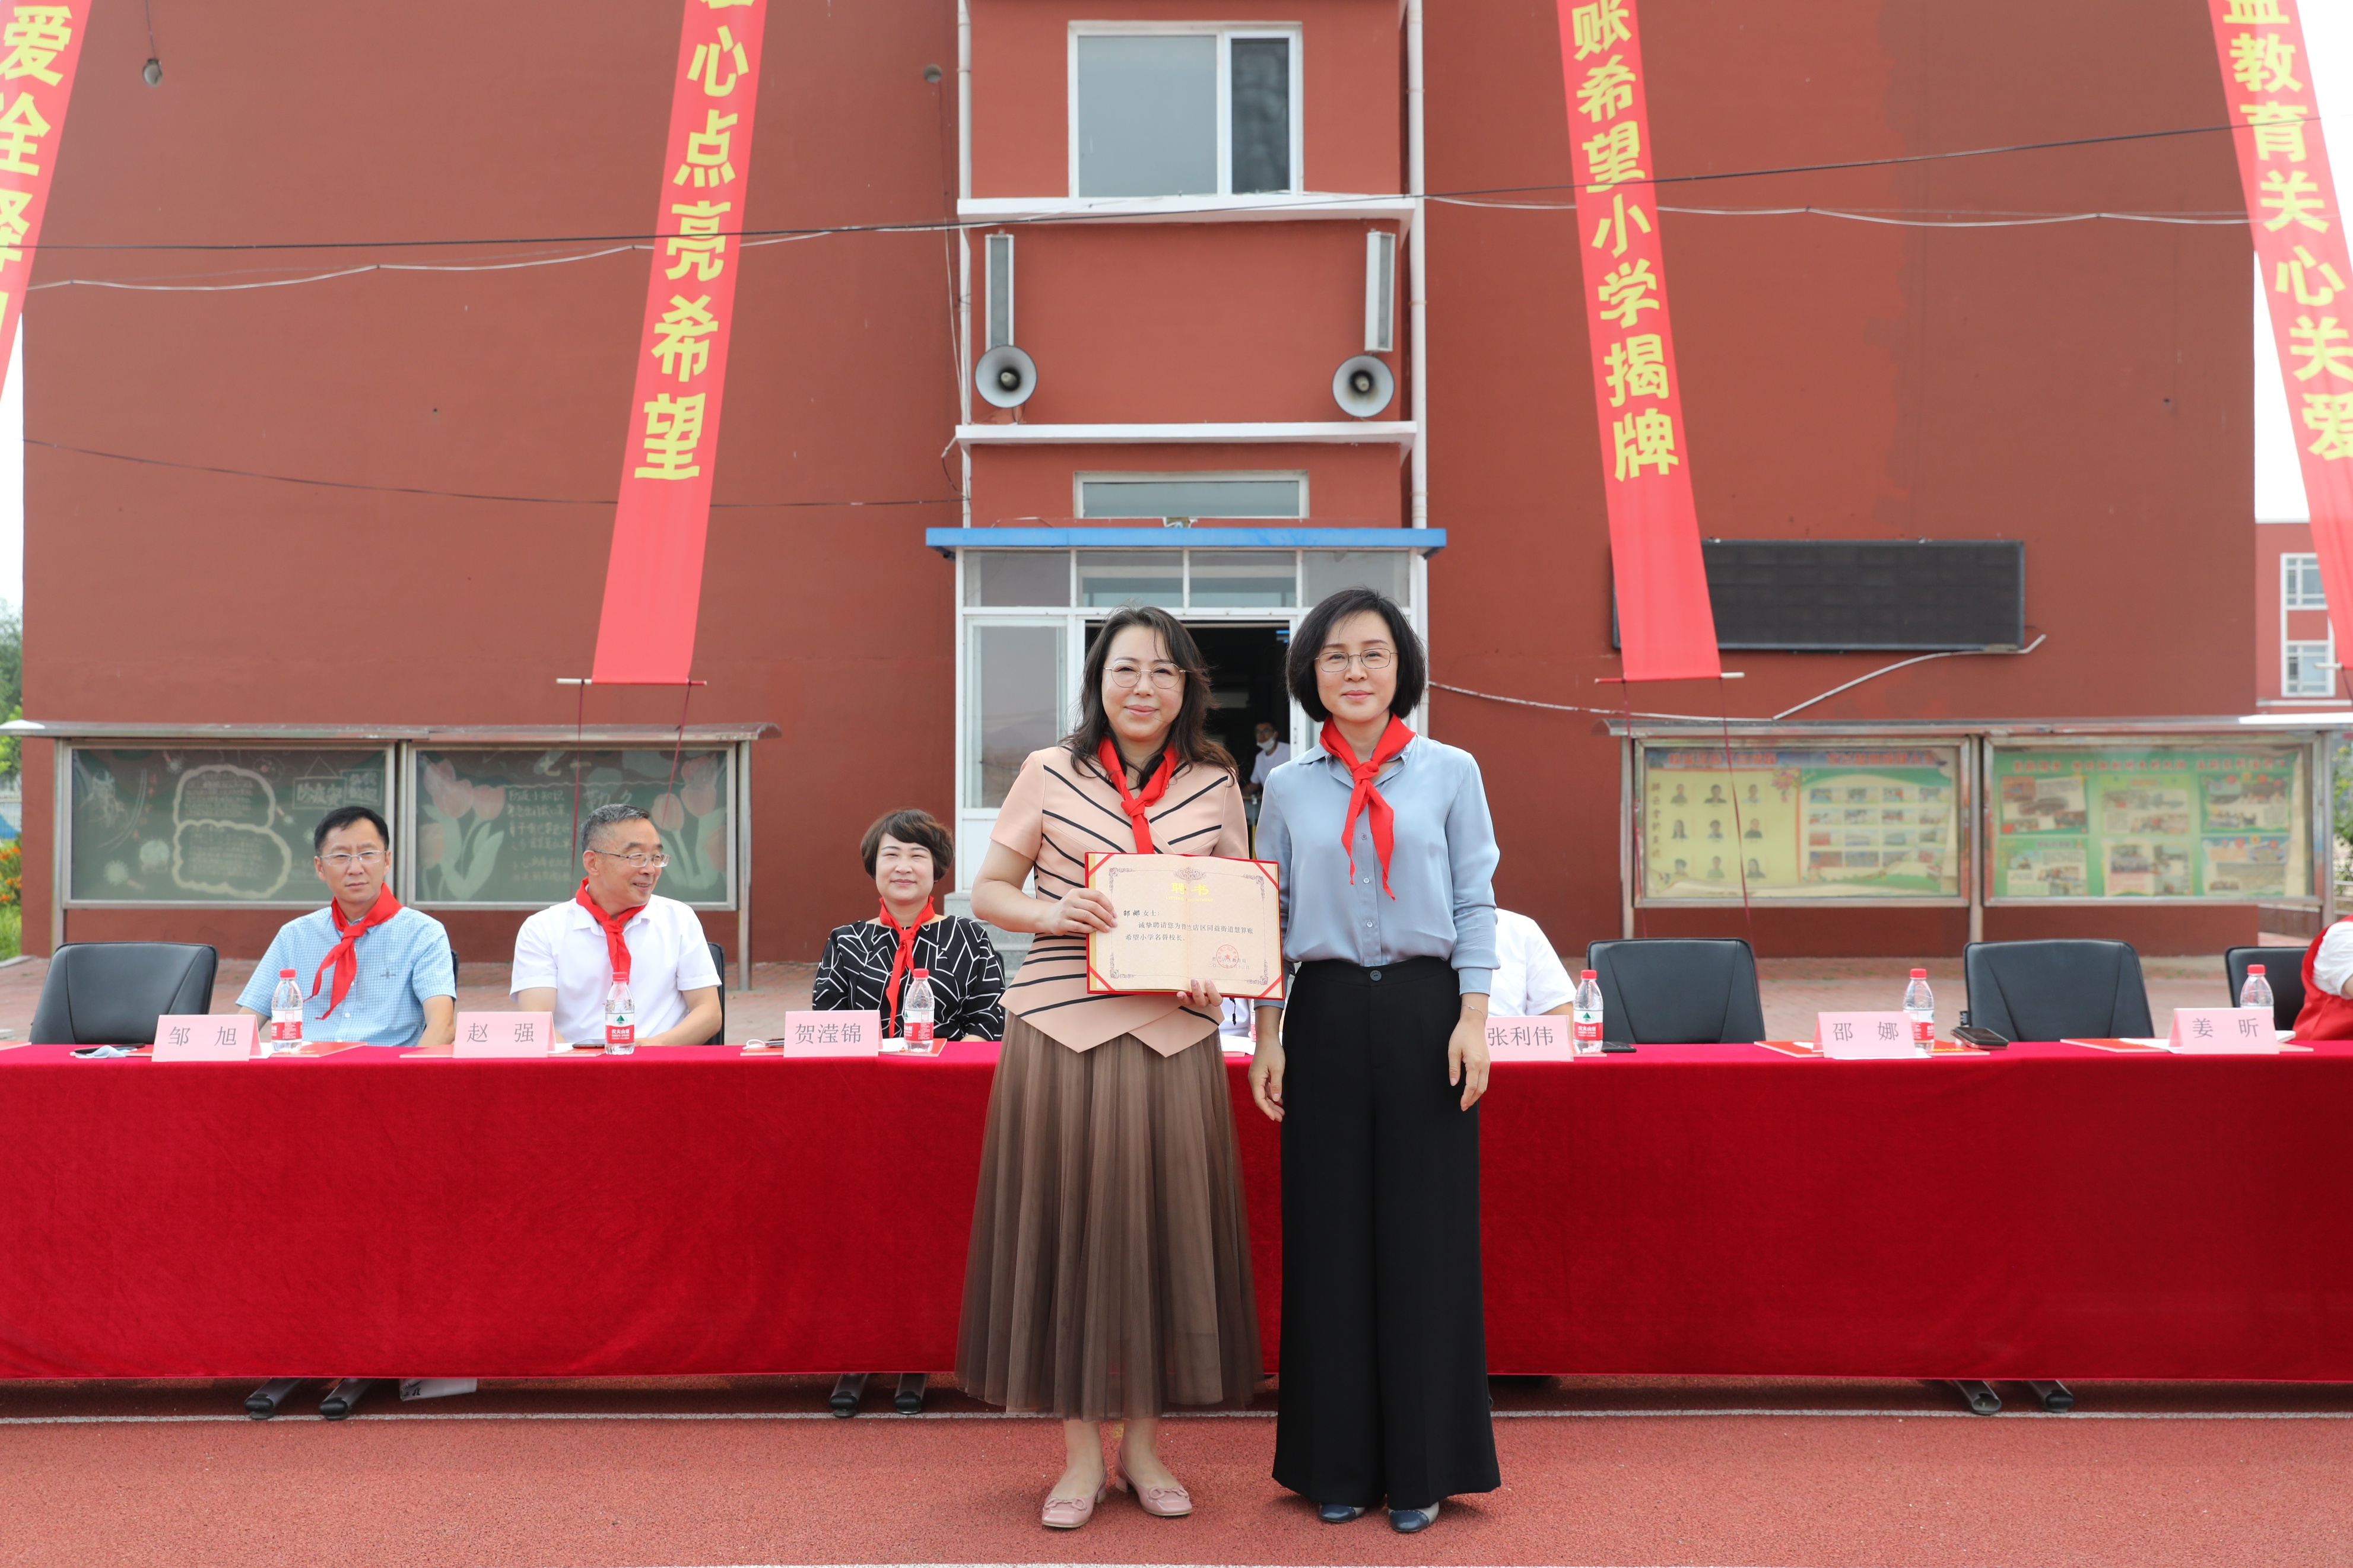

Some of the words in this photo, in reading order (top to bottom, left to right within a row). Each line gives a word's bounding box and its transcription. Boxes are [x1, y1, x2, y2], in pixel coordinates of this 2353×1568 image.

[634, 0, 754, 479] 心点亮希望
[1572, 0, 1679, 482] 账希望小学揭牌
[1170, 882, 1210, 896] 聘书
[168, 1026, 237, 1047] 邹旭
[466, 1022, 534, 1043] 赵强
[795, 1023, 862, 1044] 贺滢锦
[1487, 1026, 1554, 1047] 张利伟
[1833, 1021, 1899, 1042] 邵娜
[2192, 1017, 2259, 1038] 姜昕
